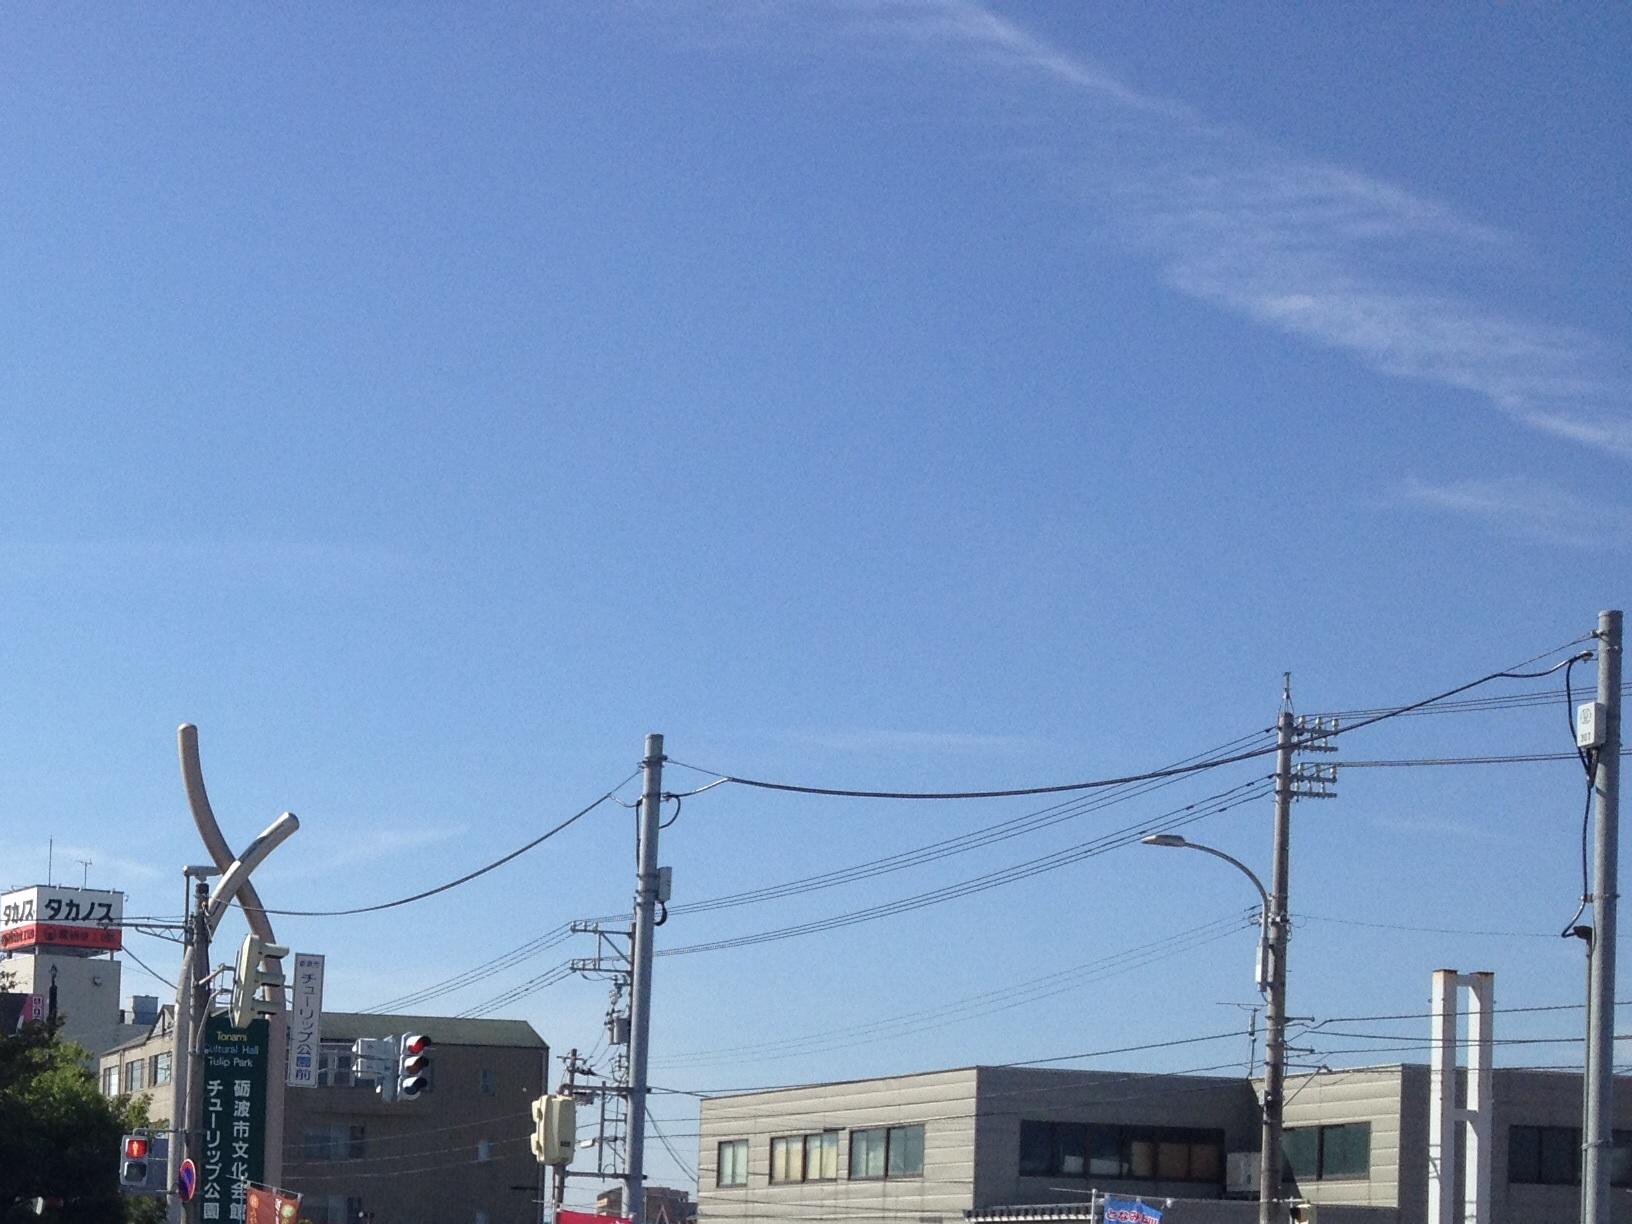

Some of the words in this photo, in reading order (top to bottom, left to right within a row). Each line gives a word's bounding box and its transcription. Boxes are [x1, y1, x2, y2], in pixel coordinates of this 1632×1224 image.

[44, 898, 114, 922] タカノス
[216, 1030, 248, 1042] Tonami
[242, 1044, 260, 1056] Hall
[208, 1056, 231, 1068] Tulip
[233, 1057, 254, 1068] Park
[203, 1079, 224, 1220] チューリップ公園
[230, 1079, 251, 1220] 砺波市文化会館
